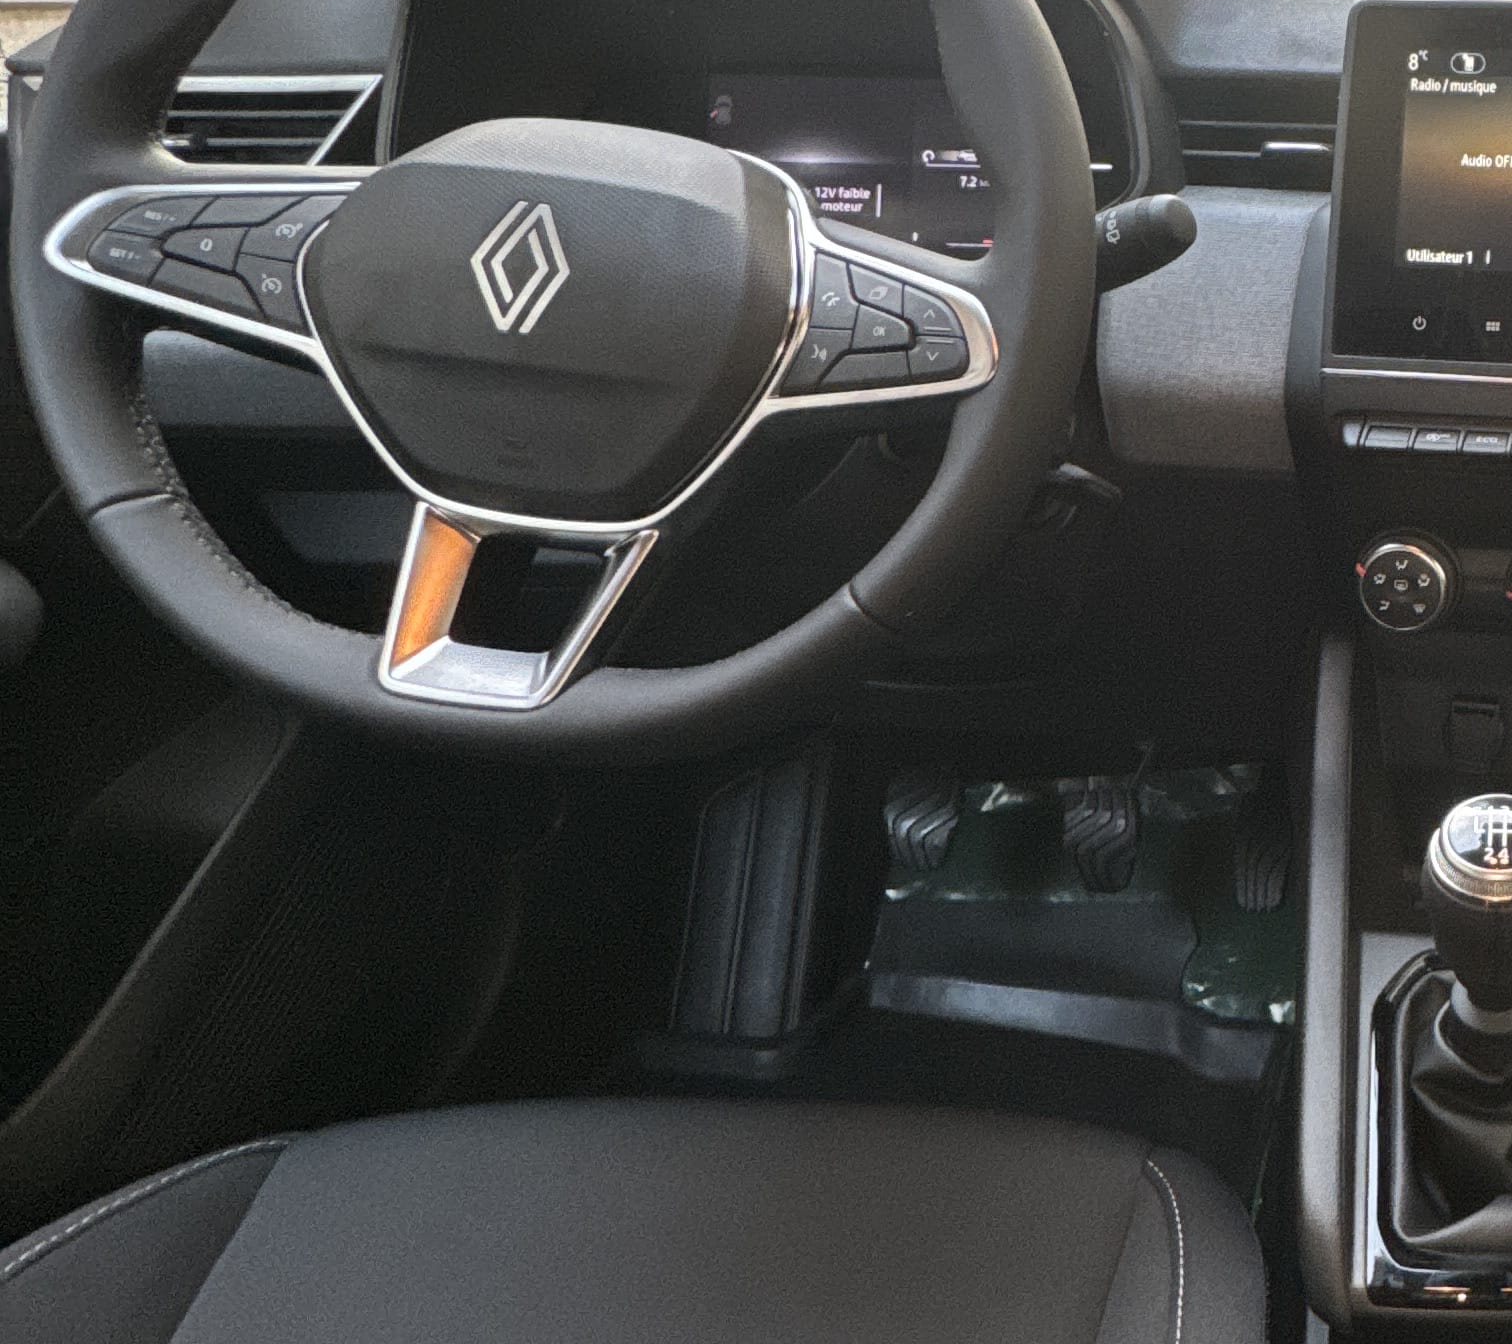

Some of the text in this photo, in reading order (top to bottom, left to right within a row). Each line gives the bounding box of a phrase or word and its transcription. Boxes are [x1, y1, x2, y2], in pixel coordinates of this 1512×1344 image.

[1410, 78, 1441, 93] Radio
[1450, 80, 1498, 96] musique
[1461, 153, 1492, 168] Audio
[1406, 248, 1464, 264] Utilisateur
